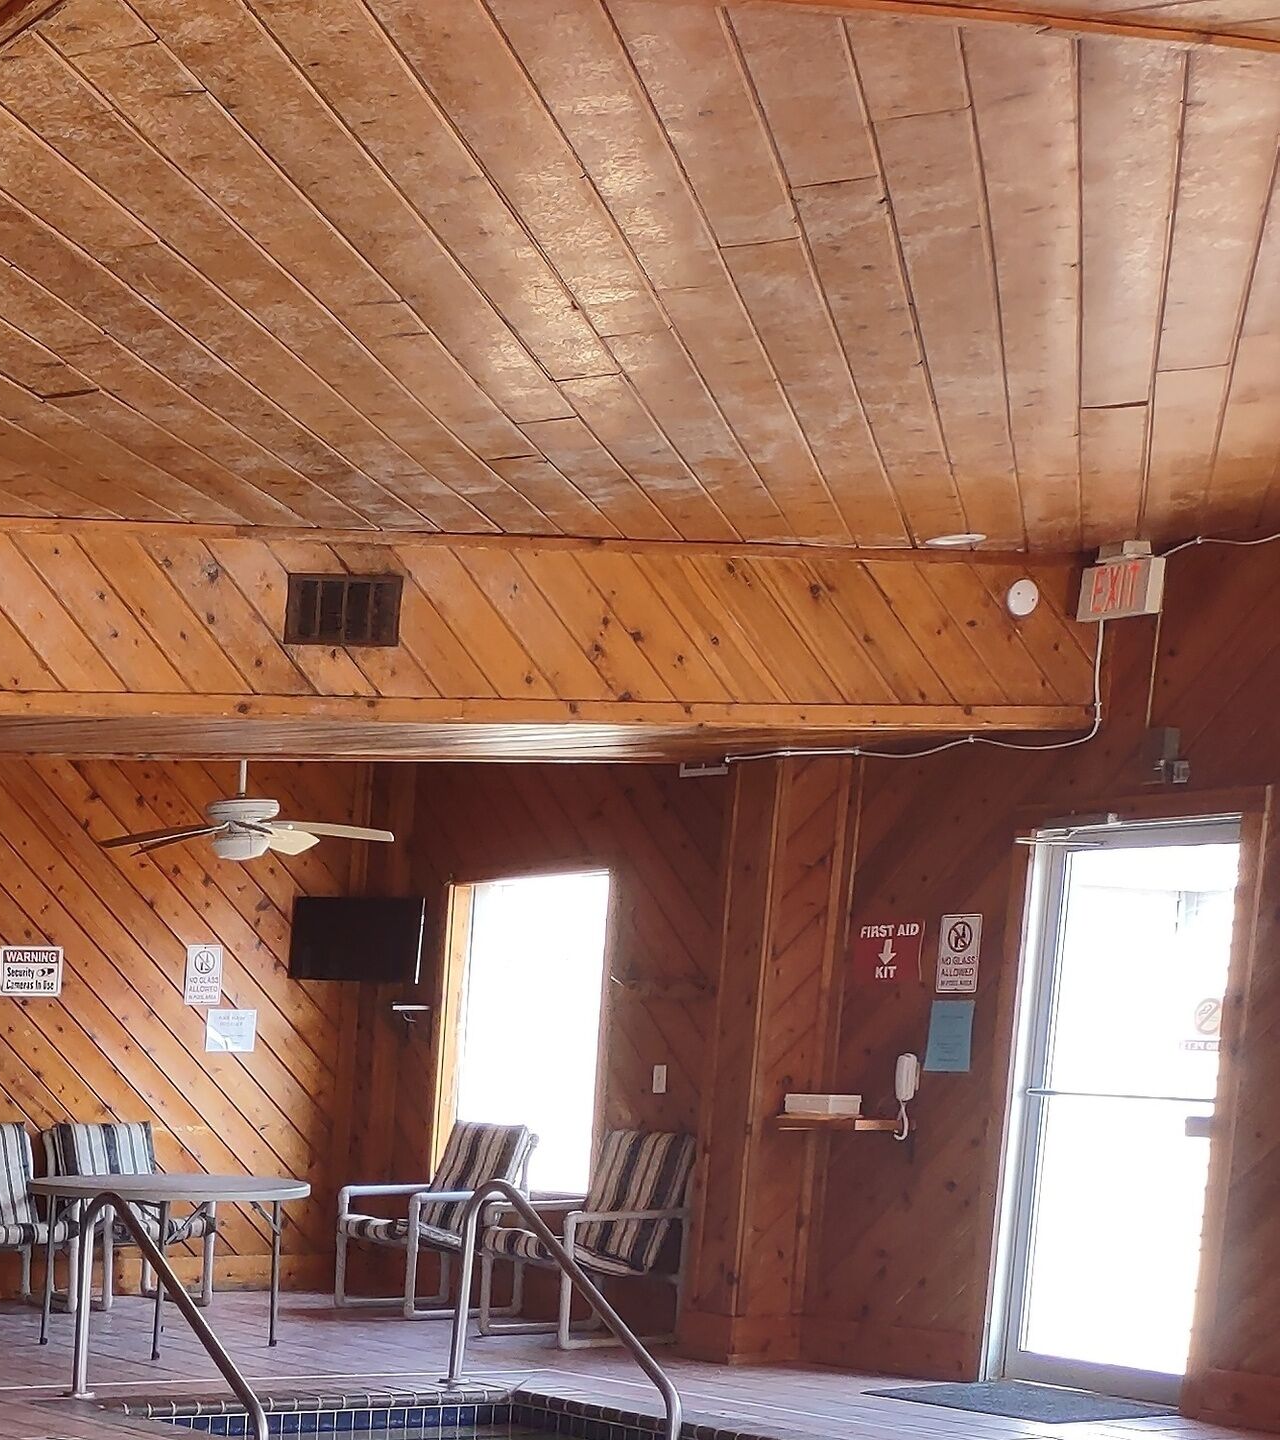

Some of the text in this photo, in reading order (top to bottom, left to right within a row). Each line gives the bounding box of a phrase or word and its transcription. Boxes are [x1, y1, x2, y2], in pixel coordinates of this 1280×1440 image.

[1090, 561, 1141, 613] EXIT
[860, 923, 920, 939] FIRST AID
[6, 951, 57, 963] WARNING
[952, 955, 976, 965] GLASS
[6, 966, 35, 979] Security
[875, 966, 897, 979] KIT
[941, 967, 974, 977] ALLOWED
[6, 979, 54, 990] Cameras In Use
[199, 976, 219, 984] GLASS
[188, 985, 217, 993] ALLOWED
